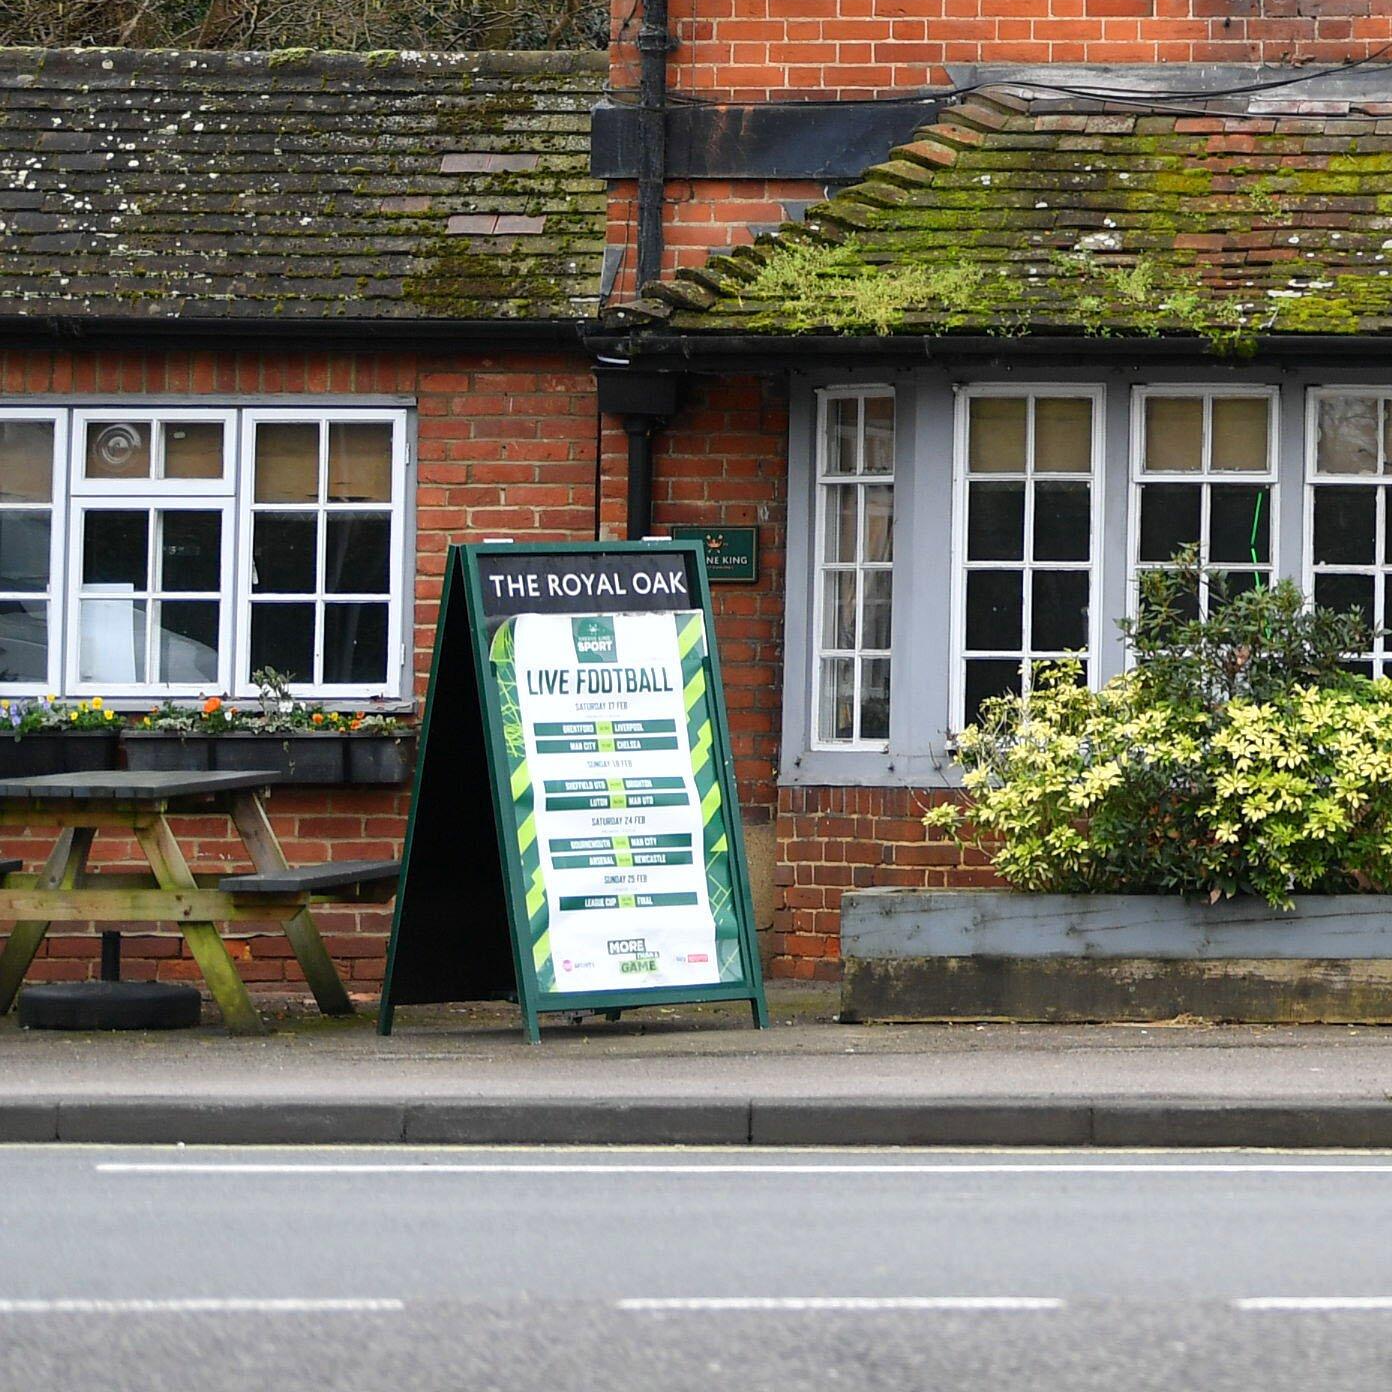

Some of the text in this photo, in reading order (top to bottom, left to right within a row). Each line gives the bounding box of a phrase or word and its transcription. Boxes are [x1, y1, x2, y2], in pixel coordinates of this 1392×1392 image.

[722, 556, 748, 565] KING
[489, 571, 687, 597] THE ROYAL OAK
[577, 641, 613, 652] SPORT
[527, 667, 674, 695] LIVE FOOTBALL
[575, 702, 606, 711] SATURDAY
[616, 701, 628, 710] FEB
[591, 815, 646, 826] SATURDAY 24 FEB
[604, 874, 648, 884] SUNDAY 25 FEB
[608, 940, 645, 954] MORE
[620, 960, 657, 973] GAME
